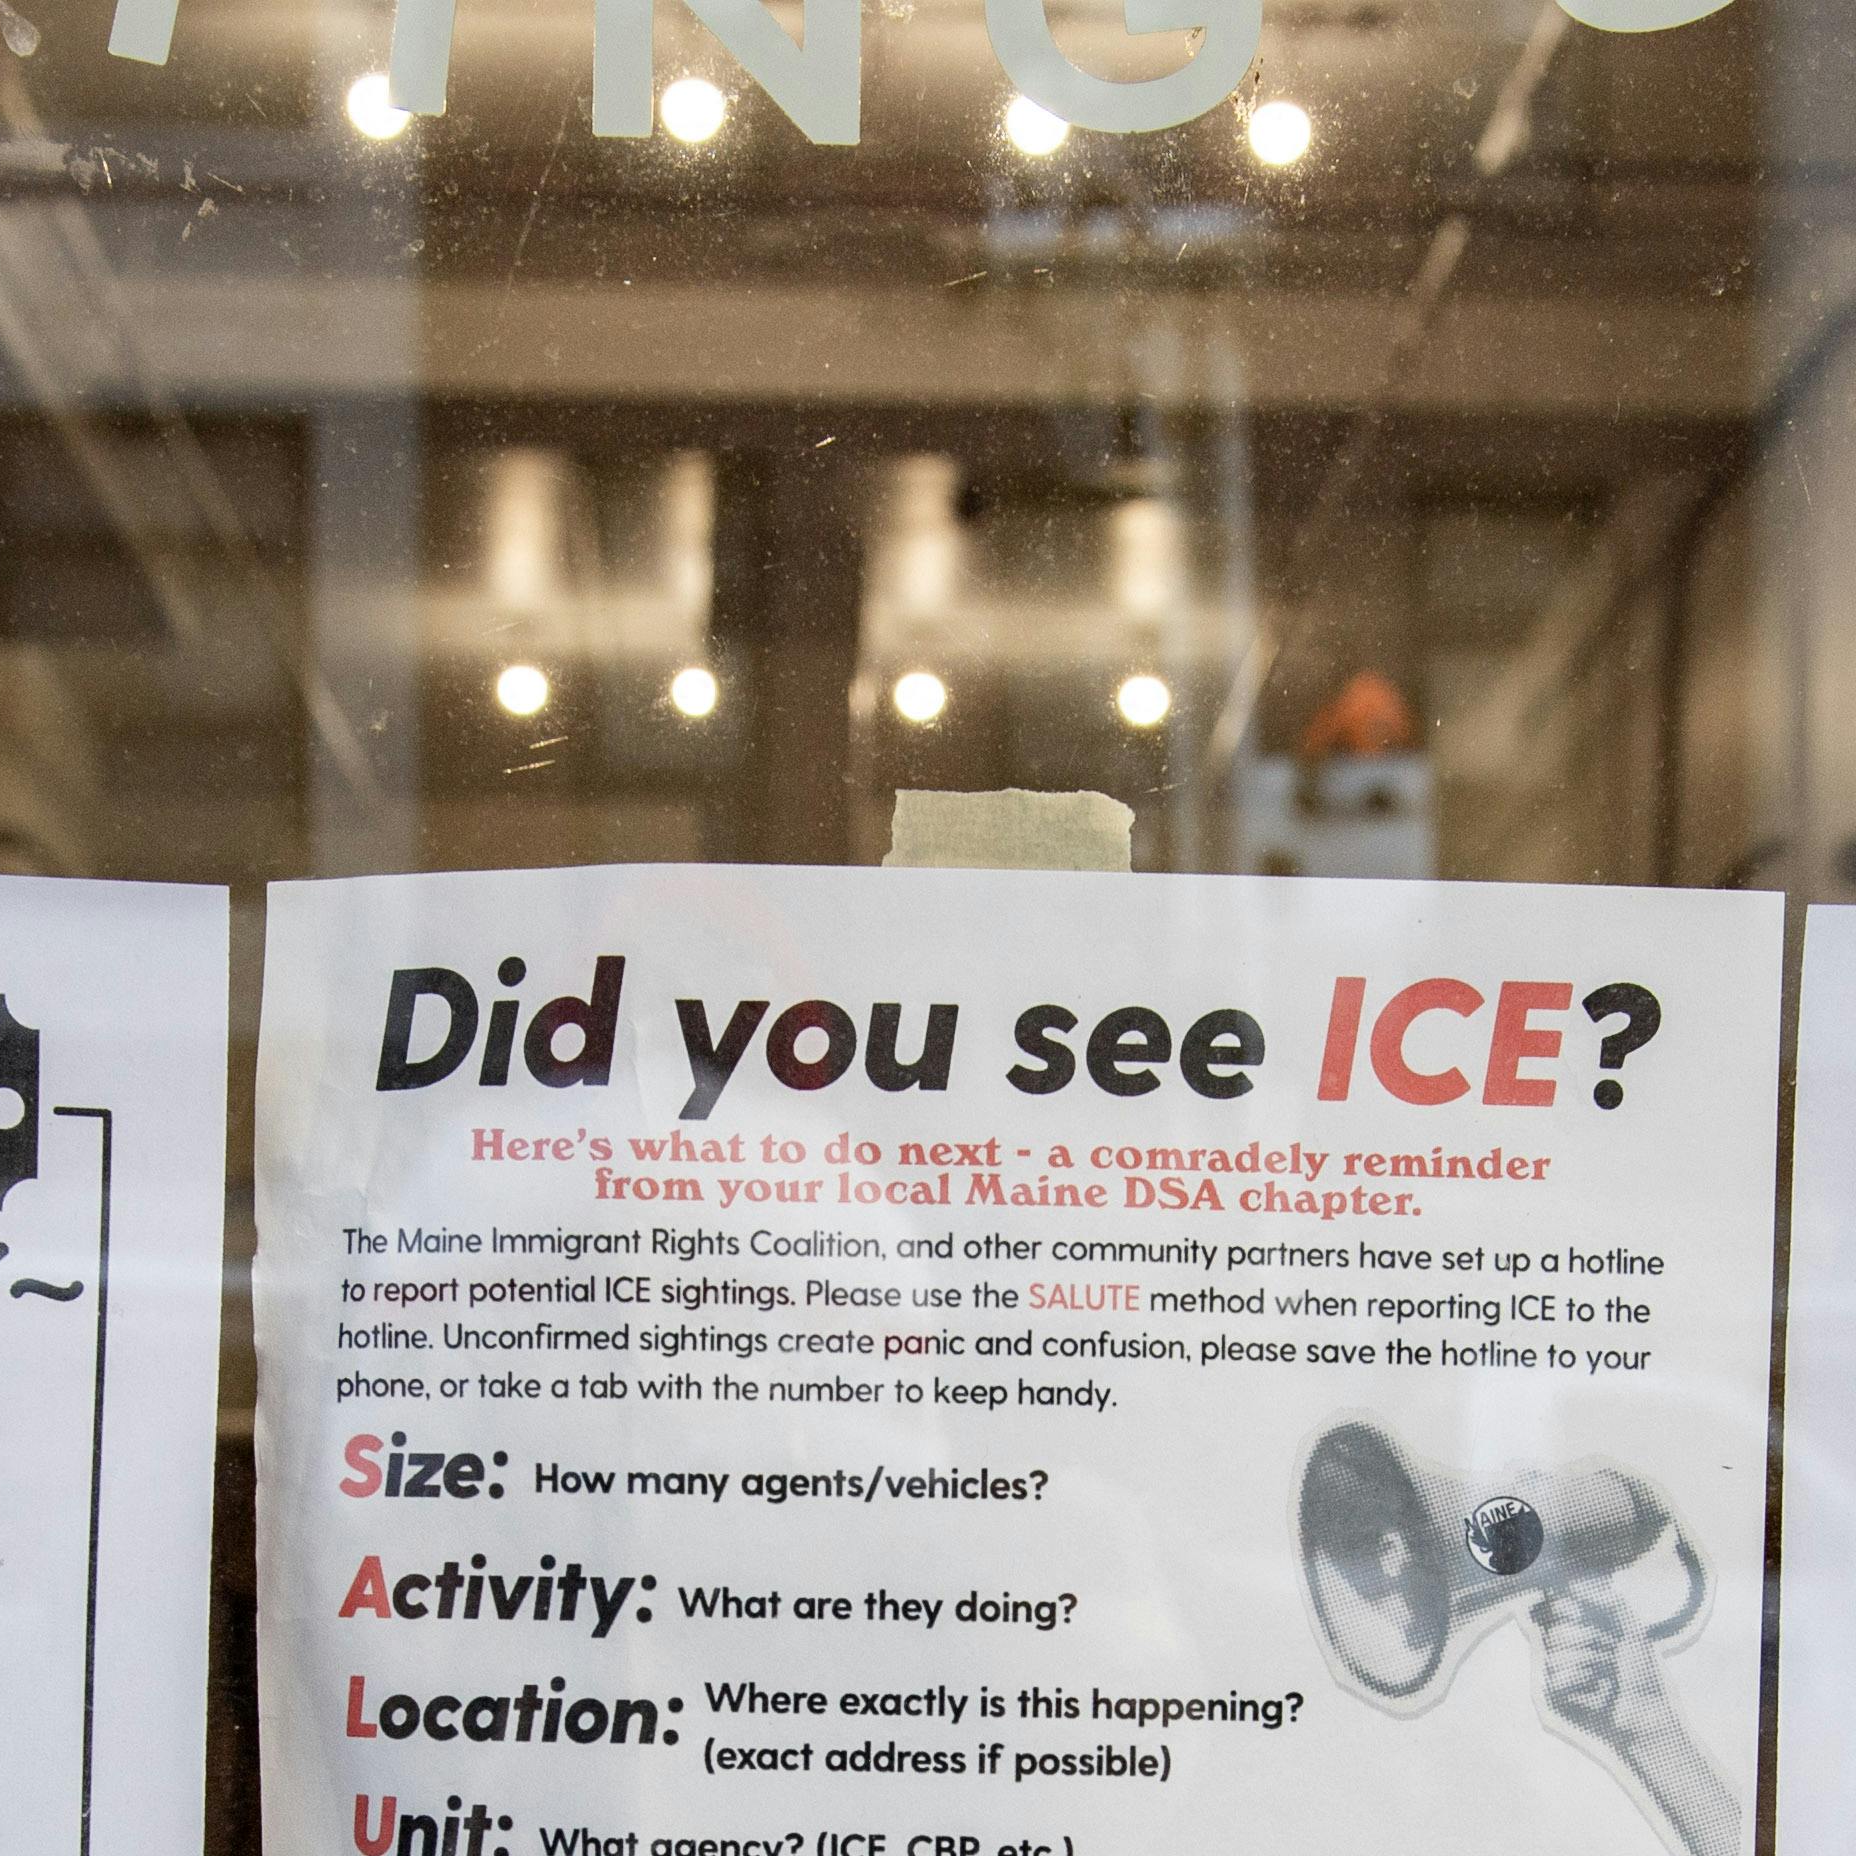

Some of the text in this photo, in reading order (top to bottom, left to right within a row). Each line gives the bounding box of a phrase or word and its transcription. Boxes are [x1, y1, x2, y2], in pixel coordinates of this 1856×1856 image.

[376, 955, 1661, 1120] Did you see ICE?
[472, 1128, 613, 1161] Here's
[628, 1130, 744, 1162] what
[761, 1135, 805, 1162] to
[825, 1132, 881, 1165] do
[898, 1137, 1002, 1167] next
[1048, 1145, 1074, 1168] a
[1090, 1142, 1329, 1182] comradely
[1343, 1147, 1551, 1180] reminder
[342, 1227, 1664, 1278] The Maine Immigrant Rights Coalition, and other community partners have set up a hotline
[340, 1431, 508, 1499] Size:
[536, 1463, 1048, 1504] How many agents/vehicles?
[339, 1554, 657, 1638] Activity:
[678, 1587, 1077, 1631] What are they doing?
[347, 1676, 683, 1745] Location:
